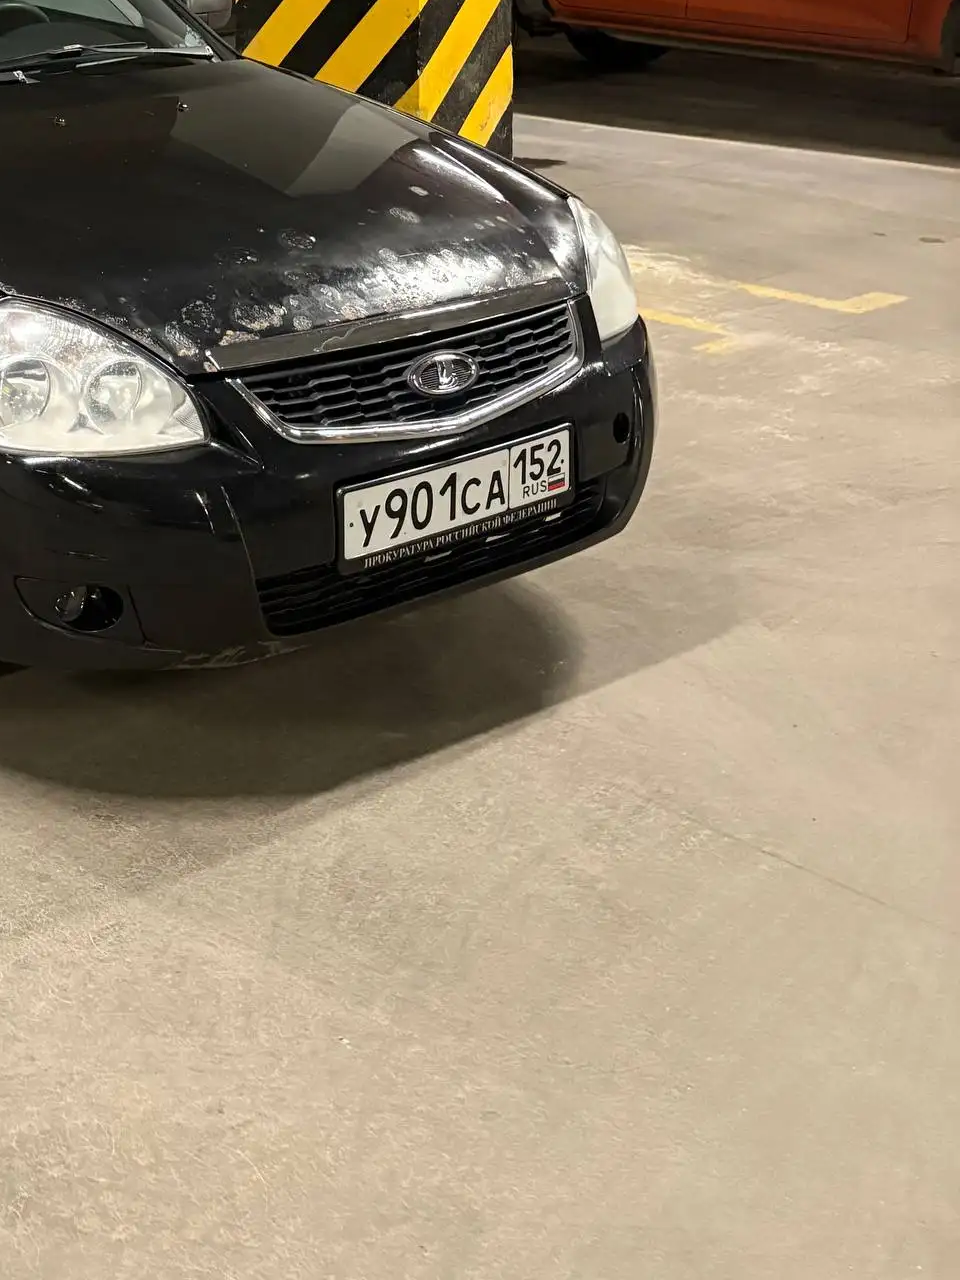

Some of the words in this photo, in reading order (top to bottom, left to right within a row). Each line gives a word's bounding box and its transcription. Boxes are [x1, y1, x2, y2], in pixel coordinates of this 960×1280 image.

[359, 470, 506, 548] У901СА
[513, 439, 562, 485] 152
[522, 480, 548, 499] RUS
[364, 539, 434, 569] ПРОКУРАТУРА
[435, 516, 501, 547] РОССИЙСКОЙ
